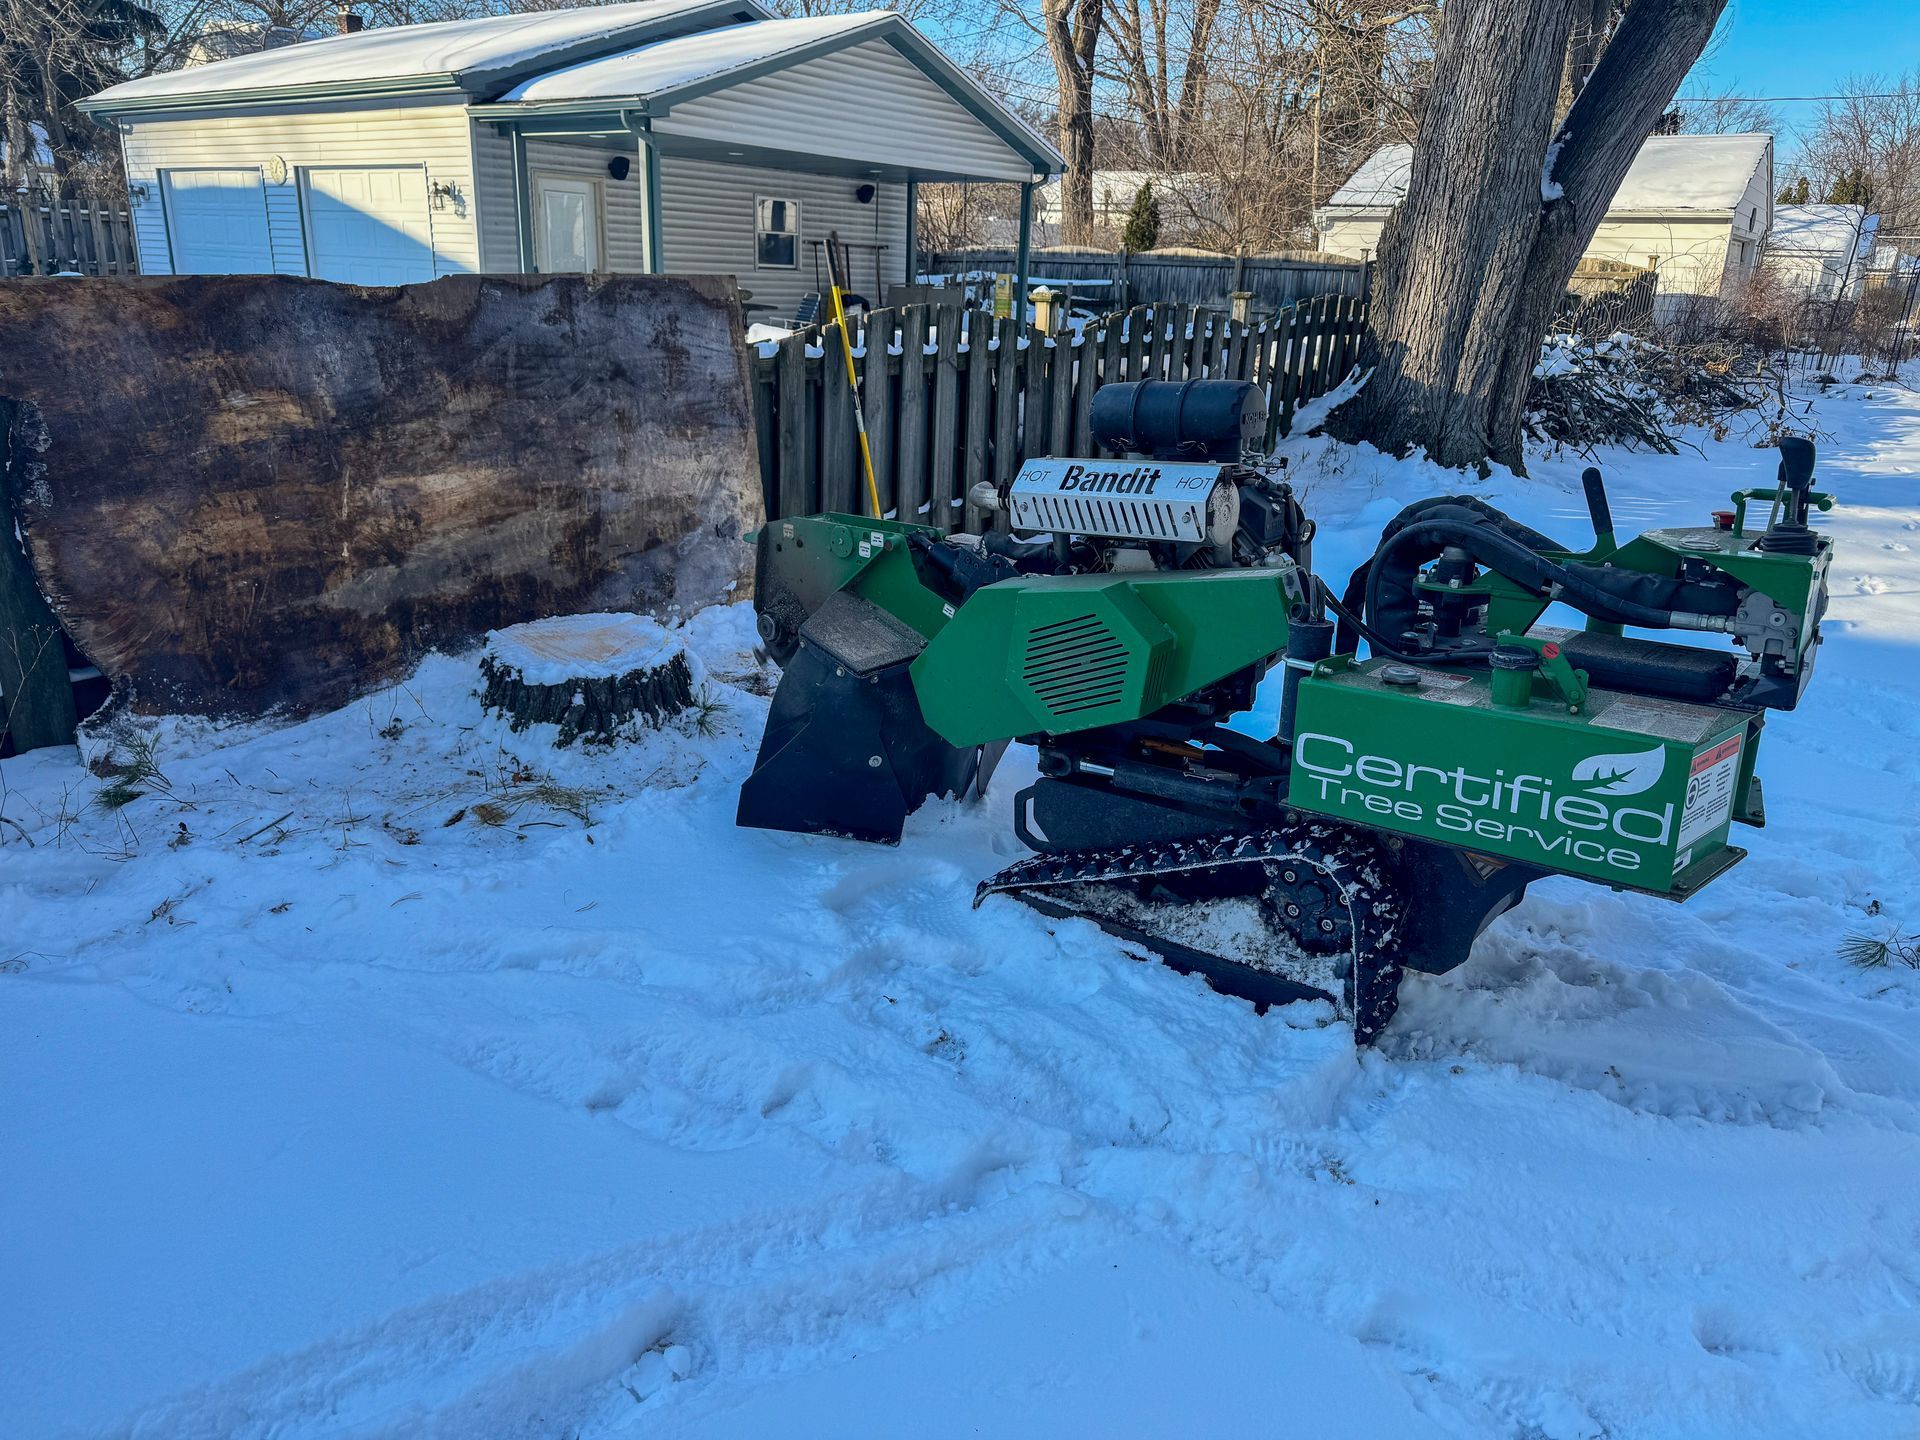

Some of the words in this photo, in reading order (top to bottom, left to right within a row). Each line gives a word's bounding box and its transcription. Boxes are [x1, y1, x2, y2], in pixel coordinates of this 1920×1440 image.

[1019, 470, 1051, 482] HOT
[1059, 465, 1162, 495] Bandit
[1175, 477, 1214, 490] HOT
[1295, 732, 1675, 846] Certified
[1308, 774, 1423, 821] Tree
[1435, 804, 1641, 870] Service
